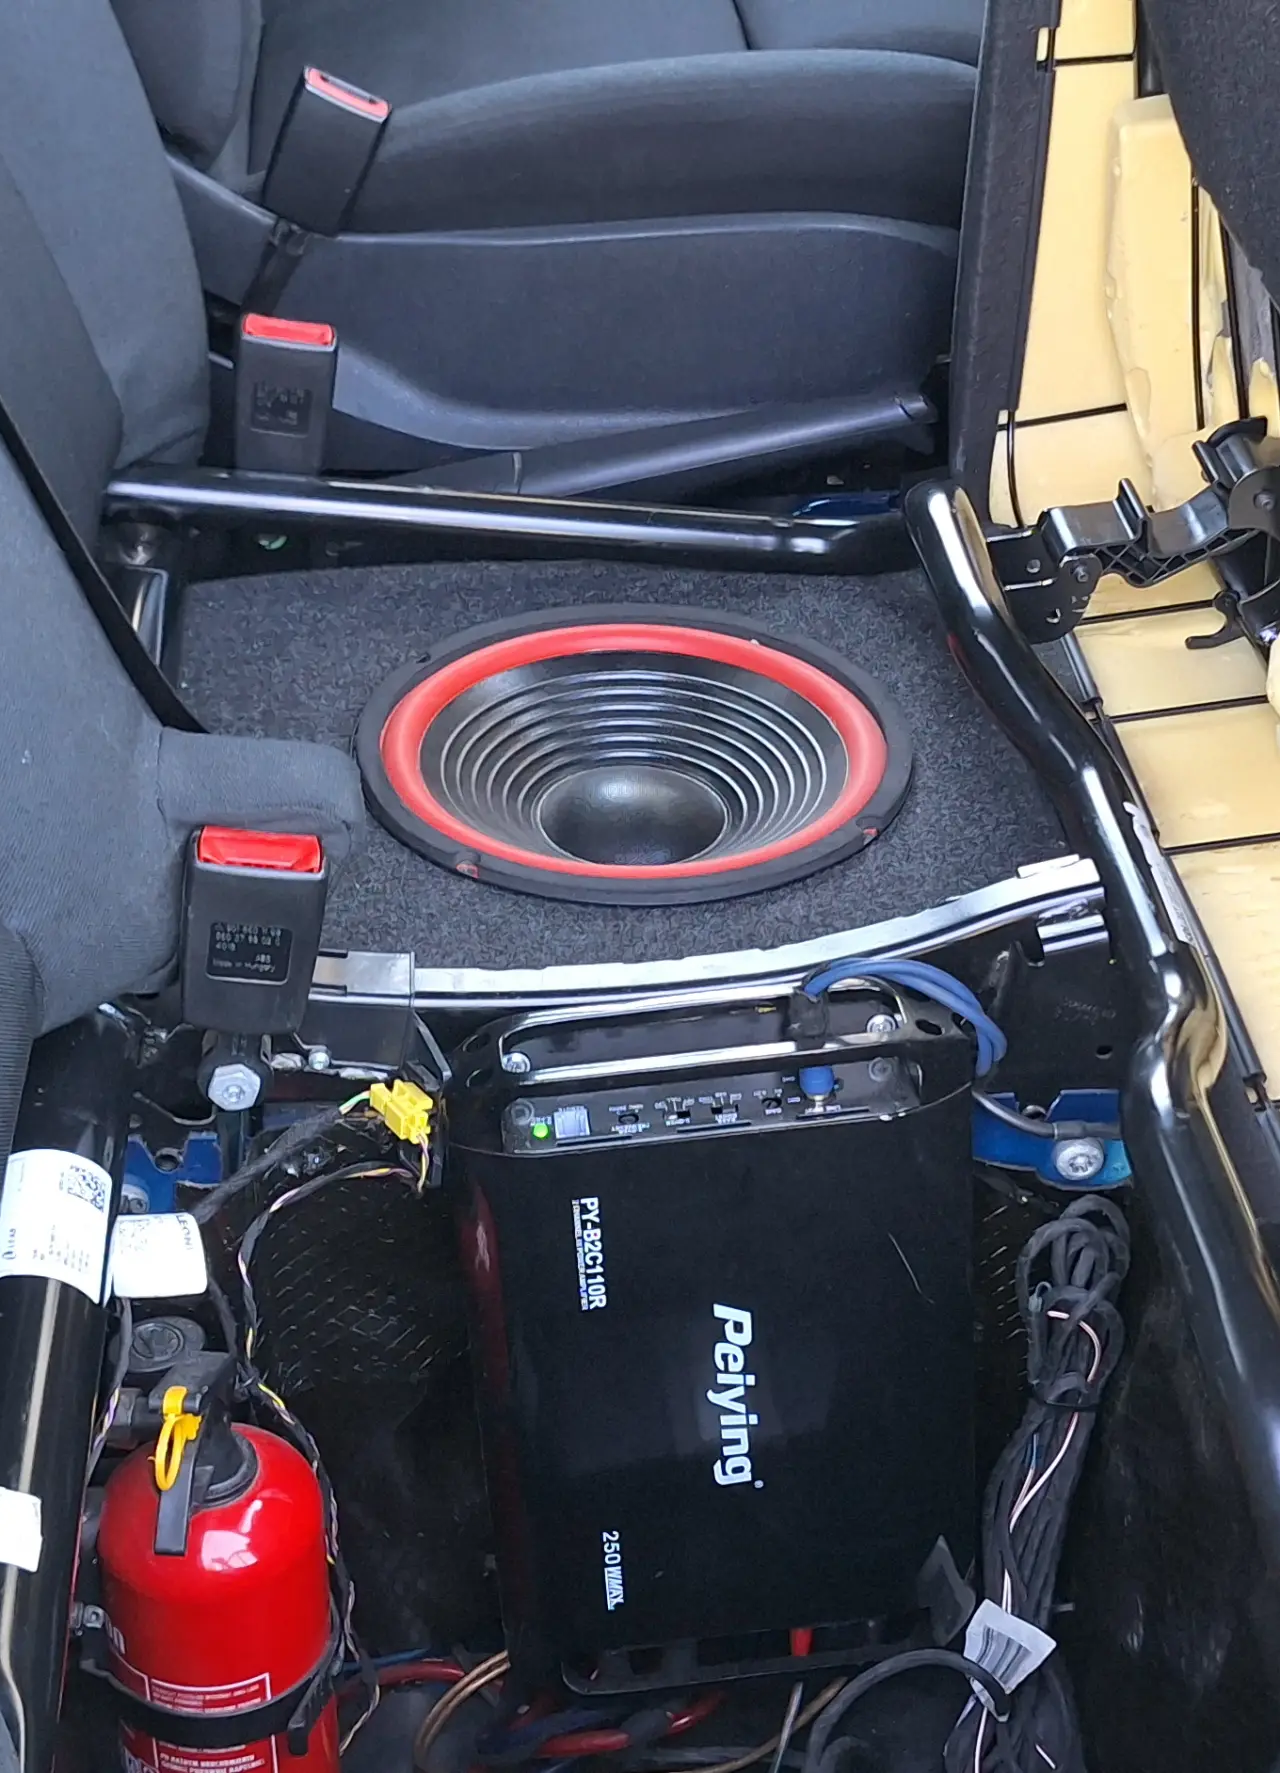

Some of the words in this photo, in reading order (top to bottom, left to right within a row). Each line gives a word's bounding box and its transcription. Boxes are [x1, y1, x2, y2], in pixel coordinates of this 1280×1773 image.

[580, 1197, 607, 1310] PY-B2C110R
[706, 1303, 759, 1486] Peiying
[602, 1530, 622, 1565] 250
